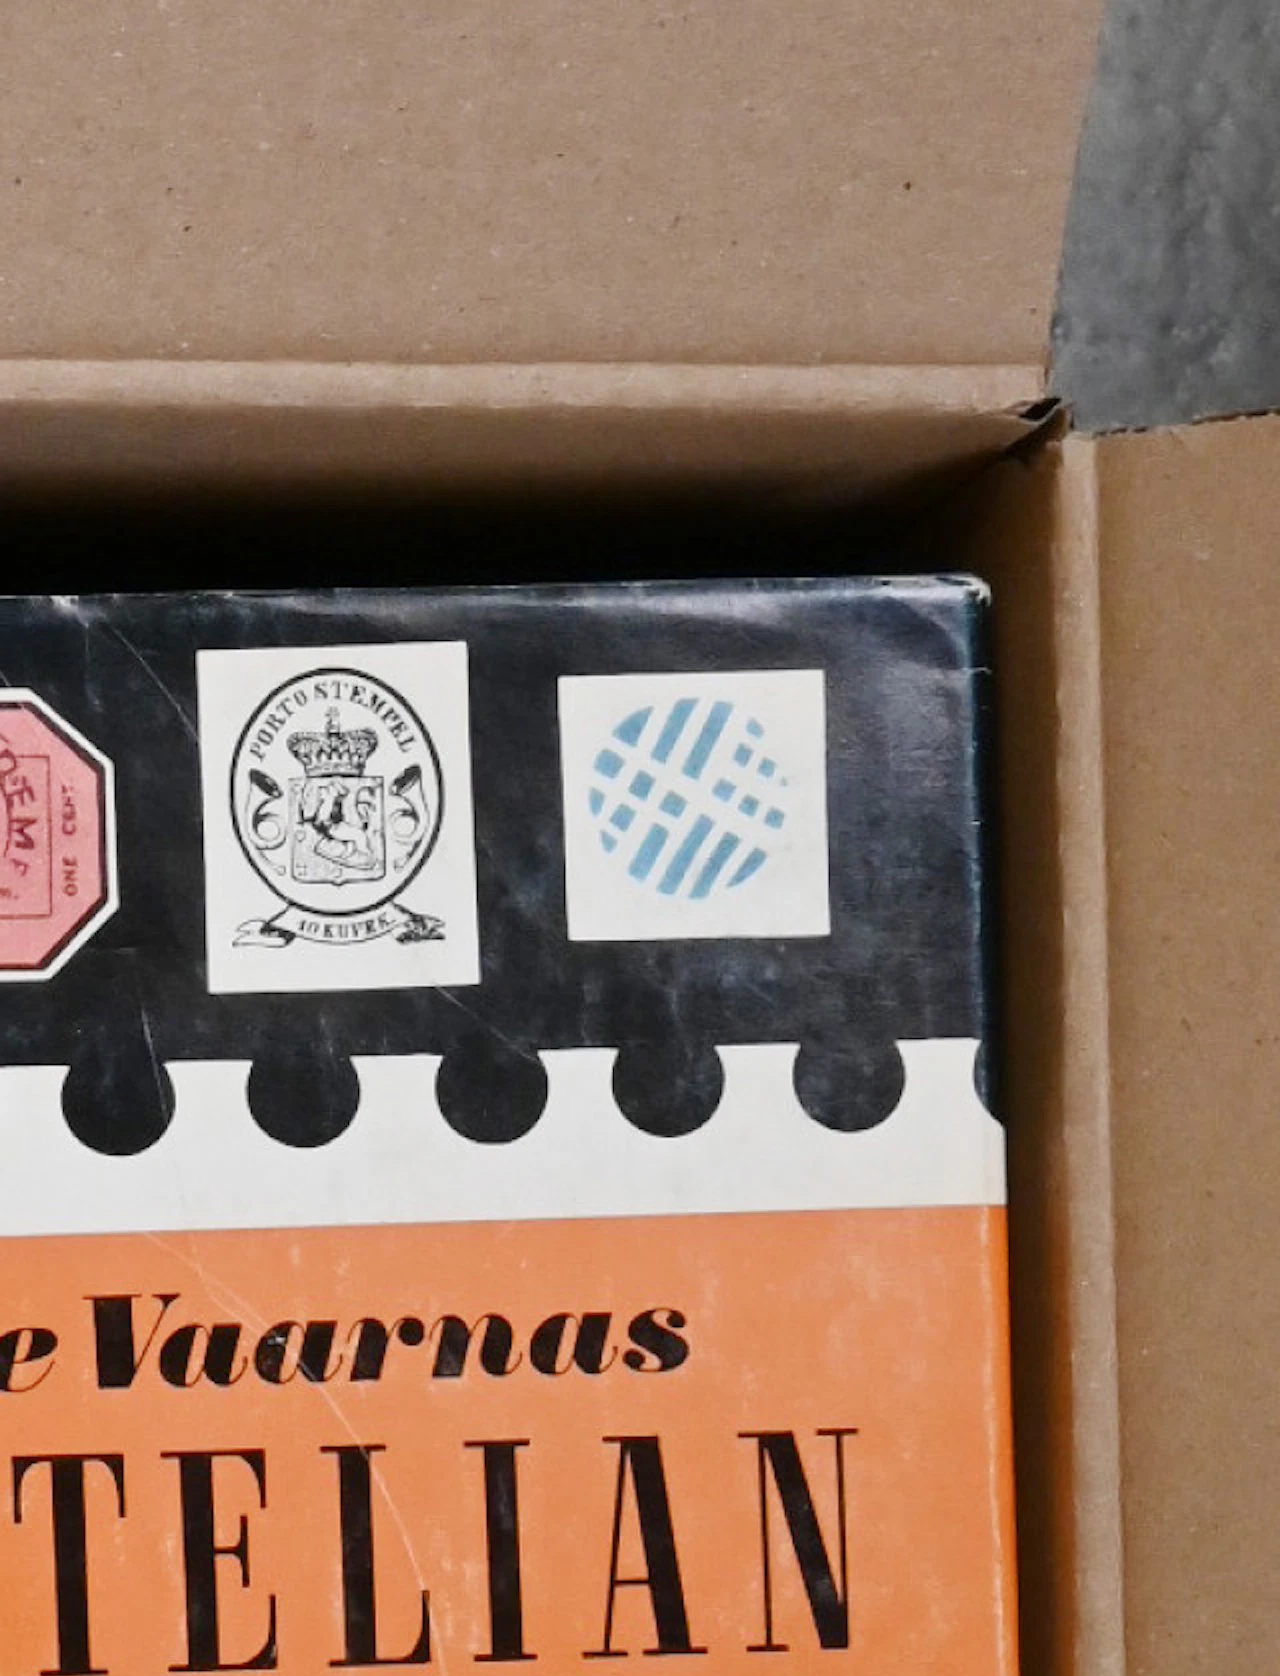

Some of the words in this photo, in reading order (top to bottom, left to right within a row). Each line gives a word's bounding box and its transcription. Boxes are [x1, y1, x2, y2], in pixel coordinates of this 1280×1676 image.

[248, 689, 308, 762] PORTO
[312, 680, 415, 754] STEMPEL
[61, 855, 80, 897] ONE
[80, 1292, 693, 1391] Vaarnas
